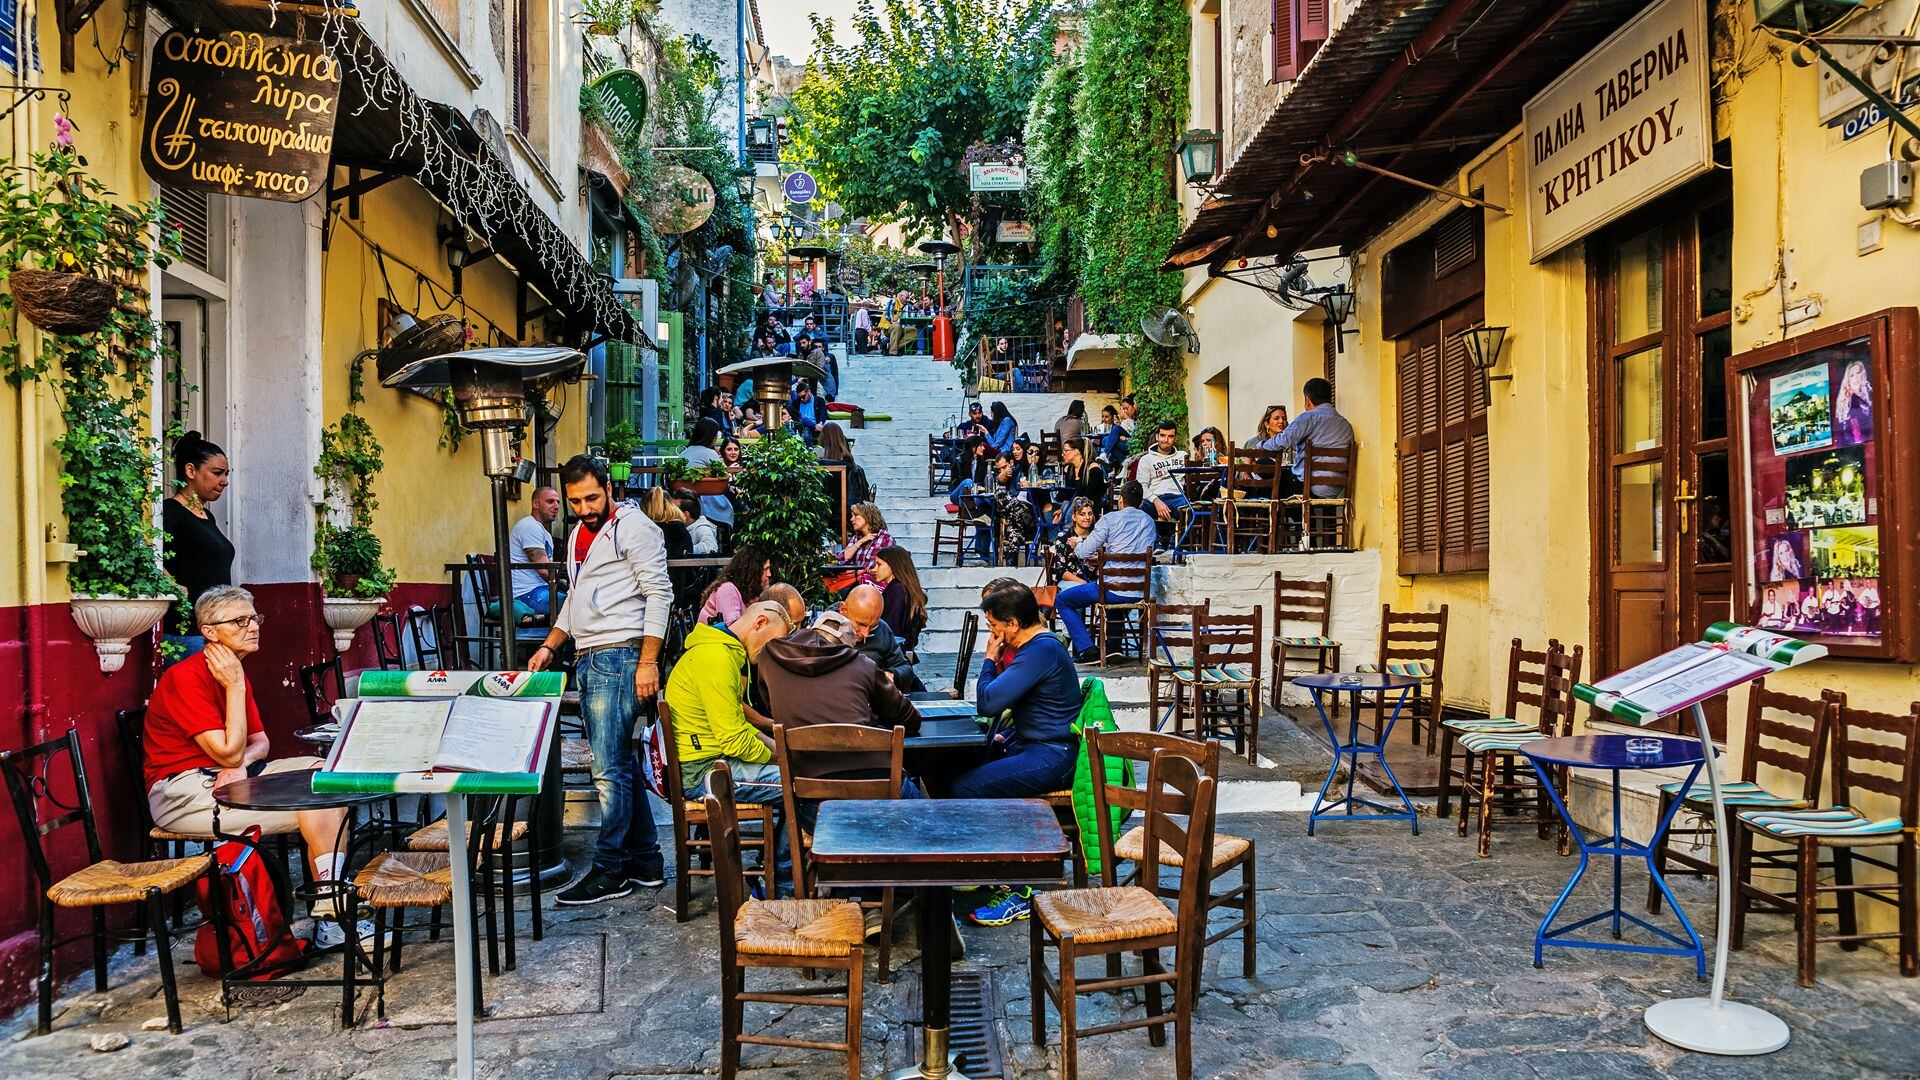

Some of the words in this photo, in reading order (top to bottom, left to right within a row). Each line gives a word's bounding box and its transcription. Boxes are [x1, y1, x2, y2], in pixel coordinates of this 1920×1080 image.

[251, 75, 333, 120] λύρα
[1534, 101, 1585, 167] ΠΑΛΗΑ
[1594, 27, 1689, 122] ΤΑΒΕΡΝΑ
